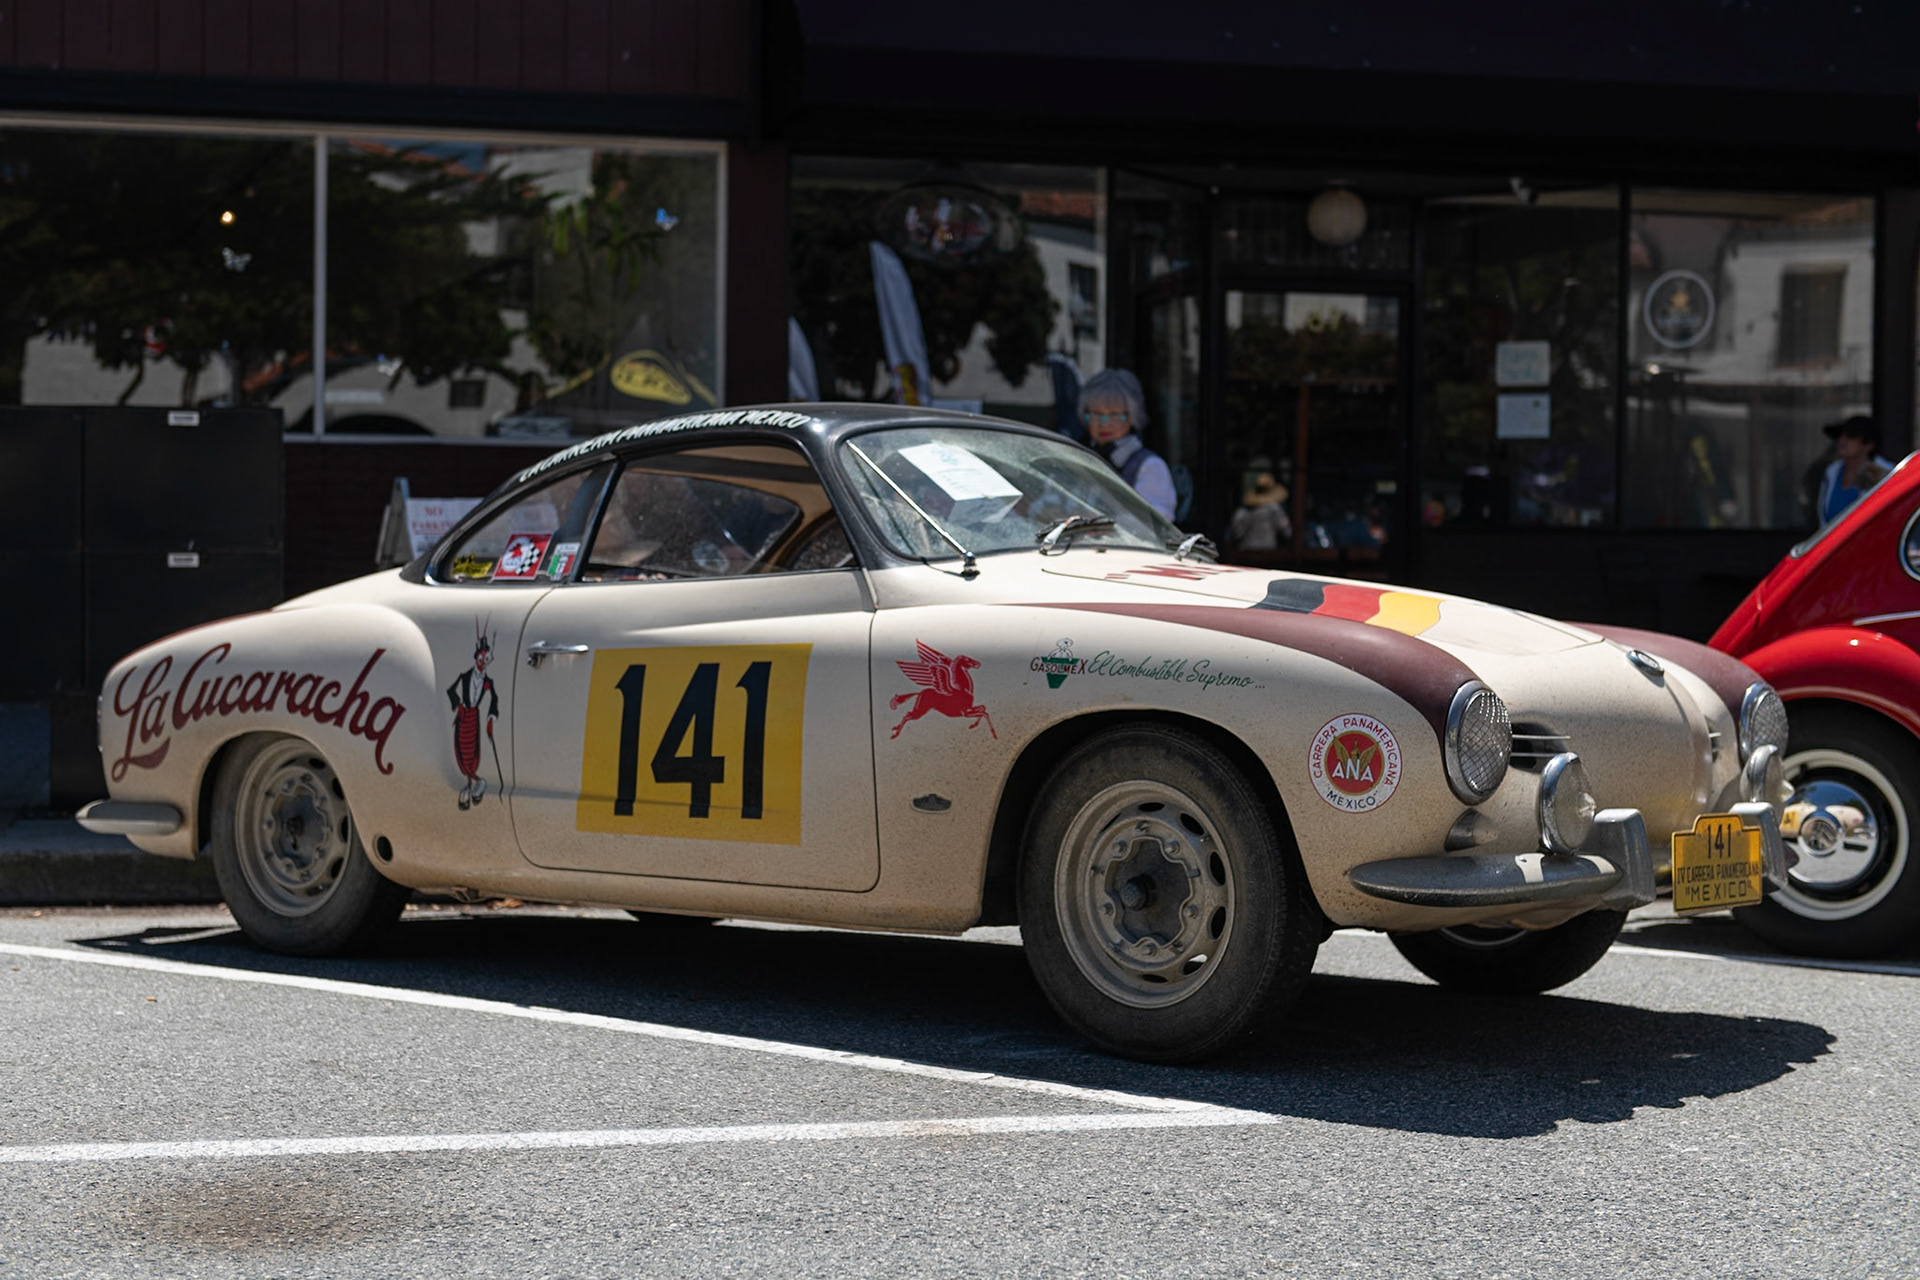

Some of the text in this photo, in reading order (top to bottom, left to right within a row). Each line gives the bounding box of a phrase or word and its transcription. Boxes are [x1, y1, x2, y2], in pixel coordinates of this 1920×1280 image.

[1088, 650, 1115, 676] El
[1109, 655, 1185, 683] Combustible
[111, 642, 407, 783] La Cucaracha
[614, 661, 773, 820] 141
[1312, 717, 1398, 787] CARRERA PANAMERICANA
[1331, 757, 1374, 783] ANA
[1707, 823, 1731, 859] 141
[1687, 864, 1715, 884] CARRERA
[1716, 861, 1759, 880] PANAMERICANA
